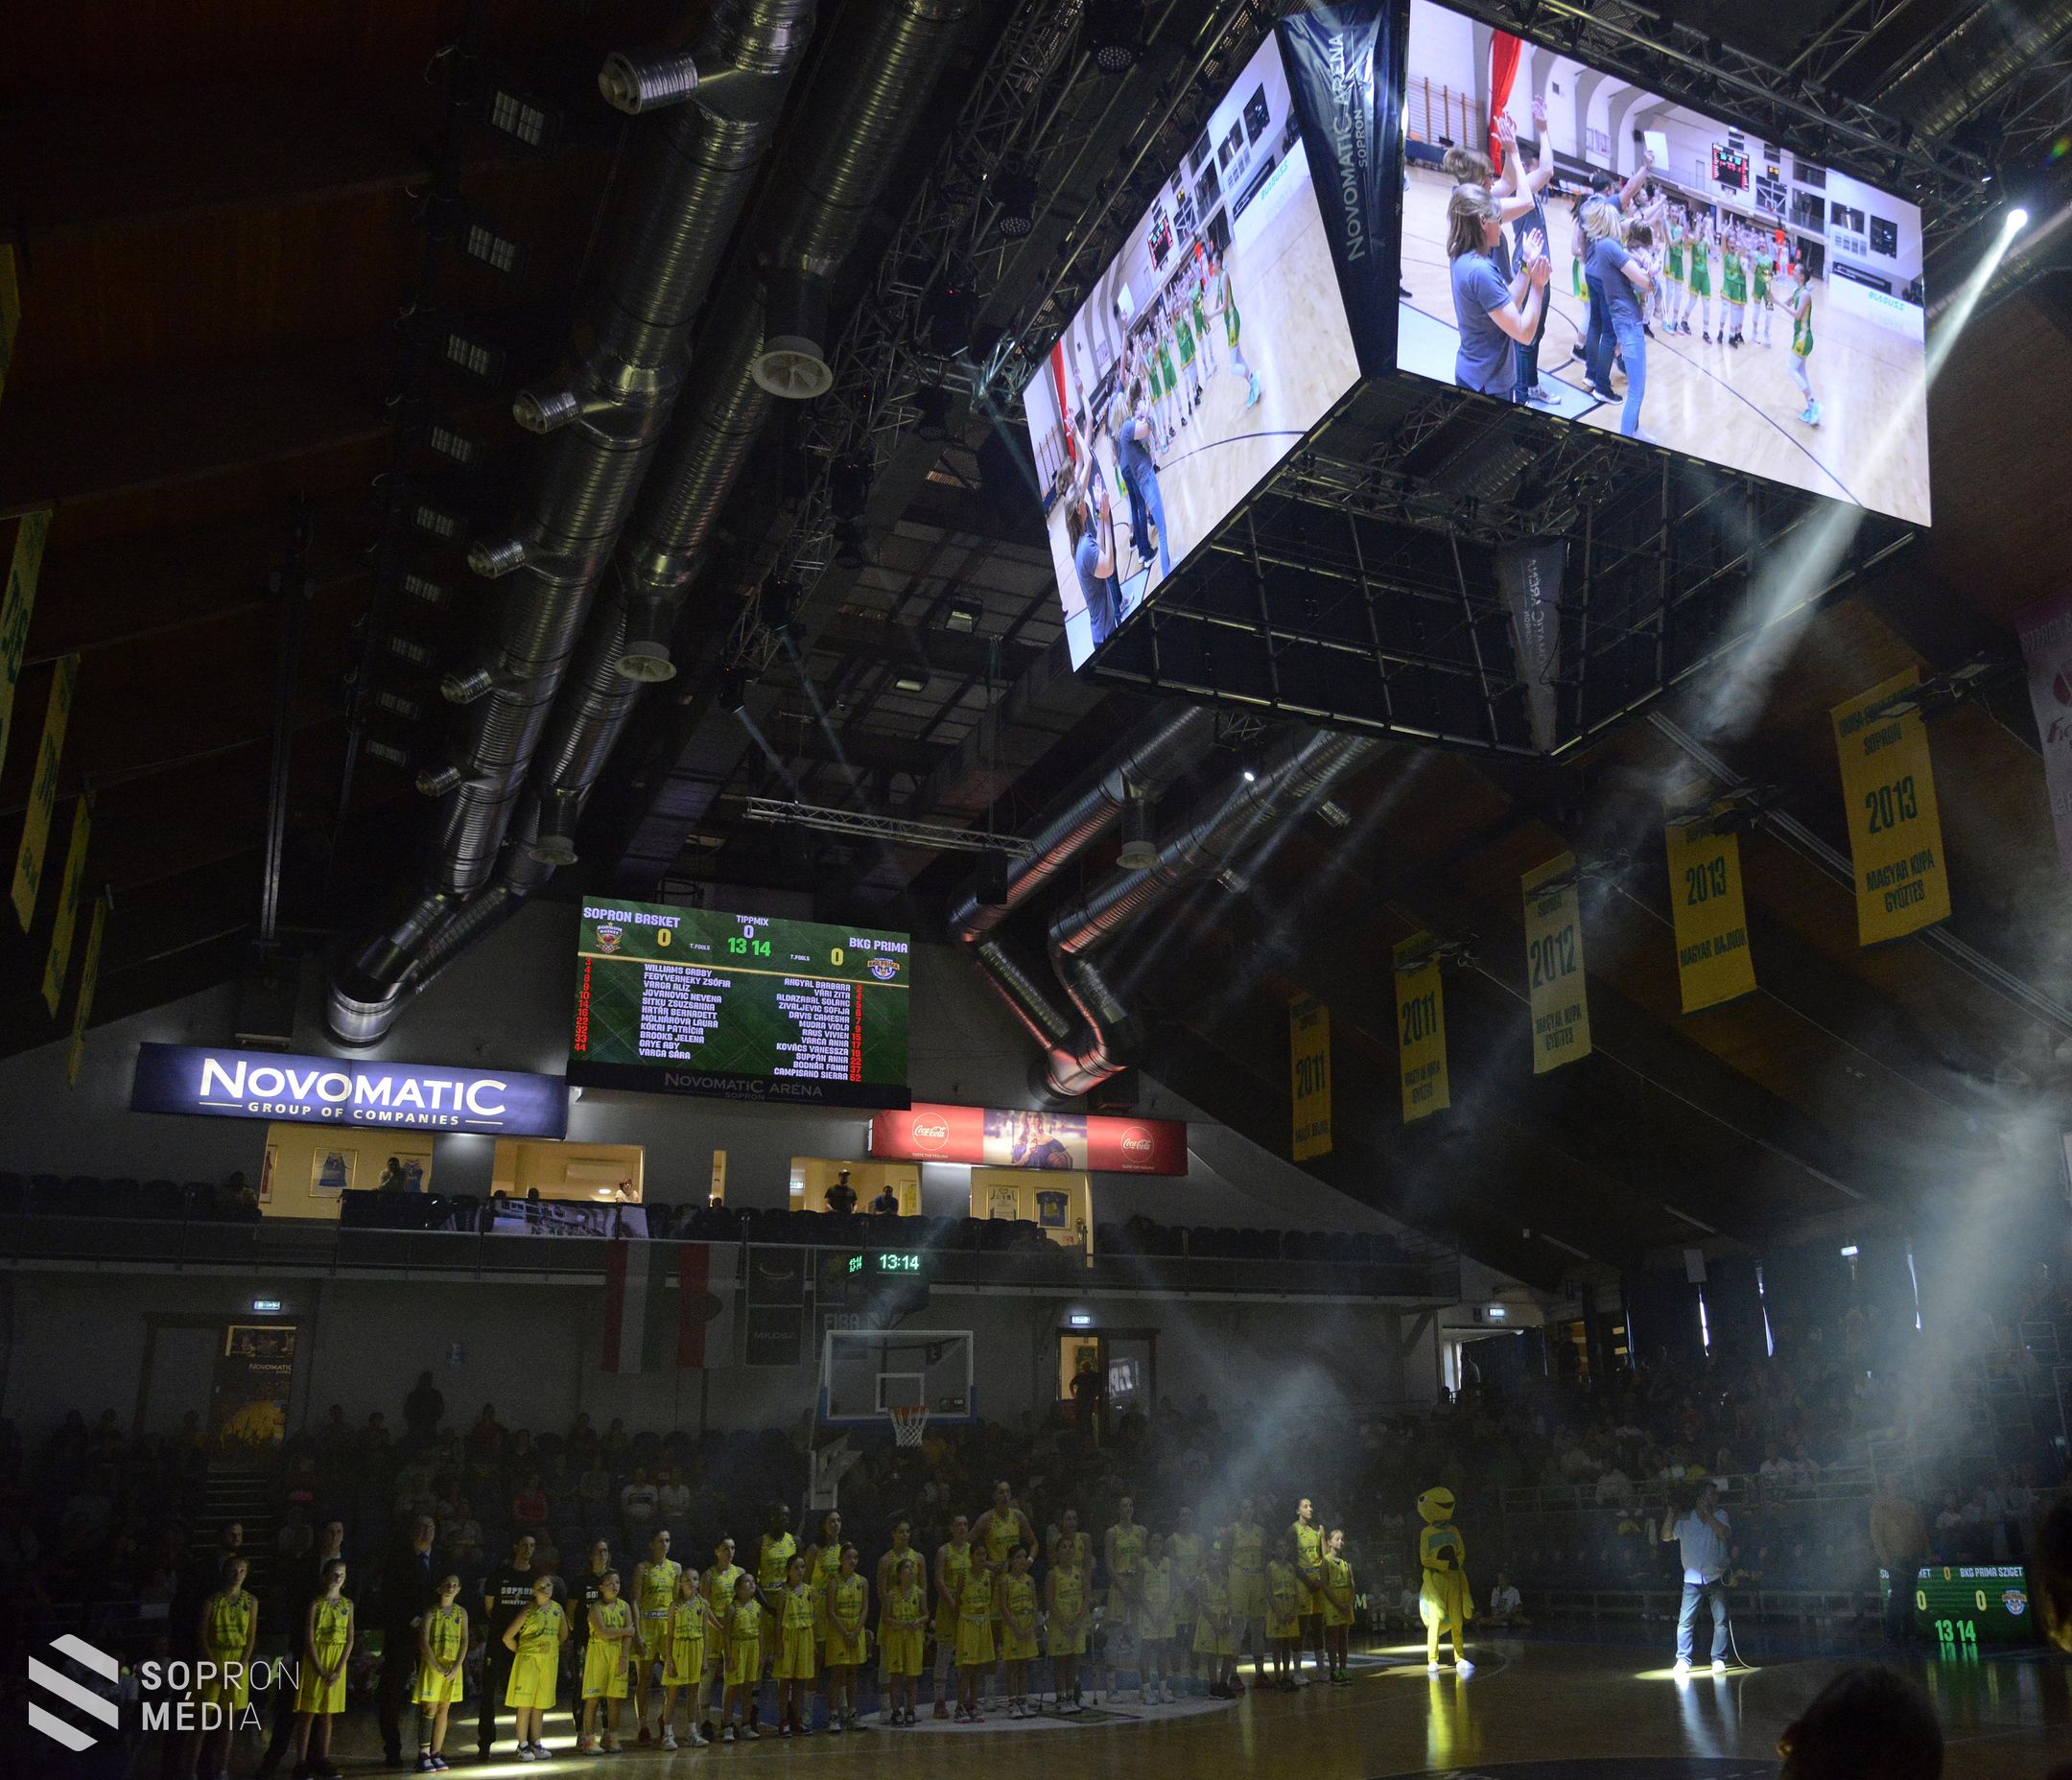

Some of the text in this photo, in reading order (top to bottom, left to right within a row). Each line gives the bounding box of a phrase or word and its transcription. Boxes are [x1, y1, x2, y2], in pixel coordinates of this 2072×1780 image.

[1354, 109, 1367, 168] SOPRON
[1333, 117, 1366, 262] NOVOMATIC
[1866, 776, 1918, 834] 2013
[1867, 849, 1935, 892] MAGYAR KUPA
[1685, 856, 1727, 905] 2013
[583, 907, 681, 928] SOPRON BASKET
[736, 915, 769, 926] TIPPMIX
[657, 928, 671, 947] 0
[743, 925, 754, 939] 0
[728, 937, 771, 956] 13 14
[849, 937, 908, 953] BKG PRIMA
[831, 948, 843, 966] 0
[1530, 925, 1576, 989] 2012
[1681, 940, 1711, 967] MAGYAR
[645, 964, 683, 974] WILLIAMS
[685, 967, 712, 977] GABBY
[644, 972, 701, 985] FEGYVERNEKY
[702, 977, 731, 988] ZSÓFIA
[644, 980, 671, 991] VARGA
[672, 982, 691, 993] ALÍZ
[784, 978, 814, 989] ANGYAL
[815, 981, 850, 992] BARBARA
[643, 989, 689, 1000] JOVANOVIC
[691, 994, 721, 1003] NEVENA
[776, 994, 820, 1004] ALDAZABAL
[813, 988, 832, 997] VÁRI
[834, 991, 850, 999] ZITA
[642, 997, 666, 1007] SITKU
[668, 1000, 715, 1012] ZSUZSANNA
[778, 1002, 822, 1012] ZIVALJEVIC
[823, 1005, 850, 1015] SOFIJA
[642, 1005, 669, 1016] HATÁR
[671, 1009, 718, 1020] BERNADETT
[789, 1011, 812, 1020] DAVIS
[813, 1014, 850, 1023] CAMESHA
[1402, 990, 1436, 1045] 2011
[641, 1022, 665, 1032] KÓKAI
[667, 1024, 704, 1035] PATRÍCIA
[693, 1019, 718, 1028] LAURA
[799, 1020, 826, 1029] MUDRA
[828, 1022, 849, 1031] VIOLA
[640, 1031, 672, 1041] BROOKS
[674, 1034, 705, 1044] JELENA
[801, 1037, 861, 1049] VARGA ANNA 17
[824, 1031, 849, 1040] VIVIEN
[852, 1033, 861, 1042] 15
[574, 1043, 691, 1060] 44 VARGA SÁRA
[639, 1040, 661, 1048] GAYE
[663, 1042, 680, 1050] ABY
[776, 1042, 808, 1052] KOVÁCS
[809, 1045, 849, 1056] VANESSZA
[795, 1053, 826, 1062] SUPPÁN
[828, 1055, 849, 1064] ANNA
[774, 1067, 819, 1078] CAMPISANO
[820, 1071, 848, 1081] SIERRA
[793, 1061, 861, 1074] BODNÁR FANNI 37
[665, 1072, 764, 1093] NOVOMATIC
[1297, 1052, 1325, 1099] 2011
[200, 1058, 507, 1115] NOVOMATIC
[724, 1092, 766, 1101] SOPRON
[247, 1102, 459, 1125] GROUP OF COMPANIES
[914, 1125, 947, 1139] Coca-Cola
[1122, 1138, 1152, 1150] Coca-Cola
[879, 1253, 920, 1271] 13:14
[1960, 1567, 1974, 1579] BKG
[1975, 1566, 1997, 1578] PRIMA
[1998, 1566, 2023, 1578] SZIGET
[1916, 1589, 1927, 1611] 0
[1975, 1589, 1987, 1611] 0
[1935, 1619, 1977, 1642] 13 14
